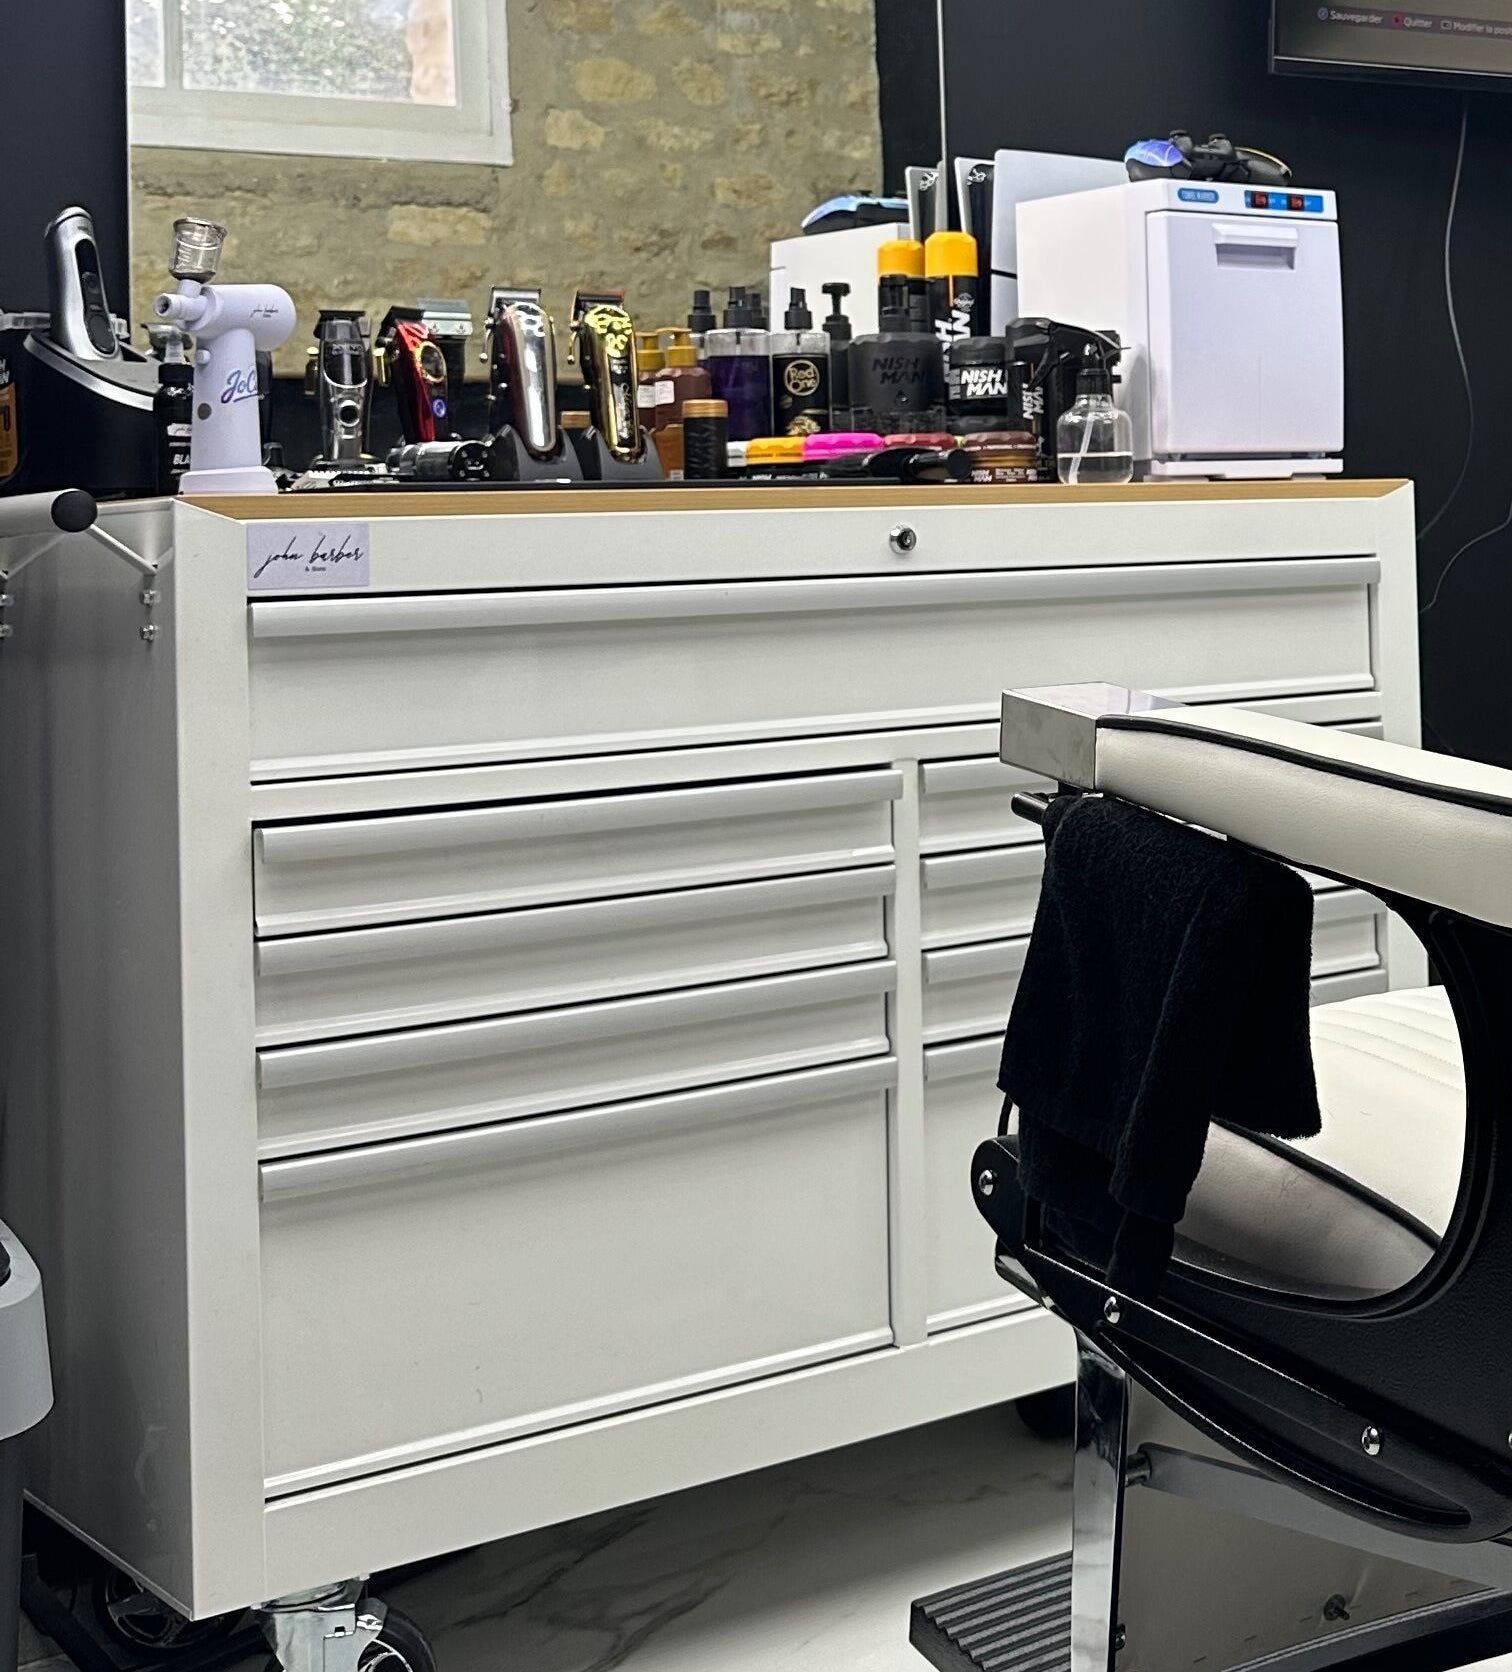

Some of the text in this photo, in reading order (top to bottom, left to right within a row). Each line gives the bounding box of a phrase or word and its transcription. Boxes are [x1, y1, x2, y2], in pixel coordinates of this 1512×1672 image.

[1330, 10, 1383, 25] Sauvegarder
[1403, 17, 1433, 29] Quitter
[1453, 21, 1485, 34] Modifier
[872, 357, 920, 372] NISH
[788, 366, 816, 380] Red
[879, 370, 926, 386] MAN
[960, 368, 1002, 385] NISH
[966, 383, 1008, 397] MAN
[253, 533, 364, 579] john barber
